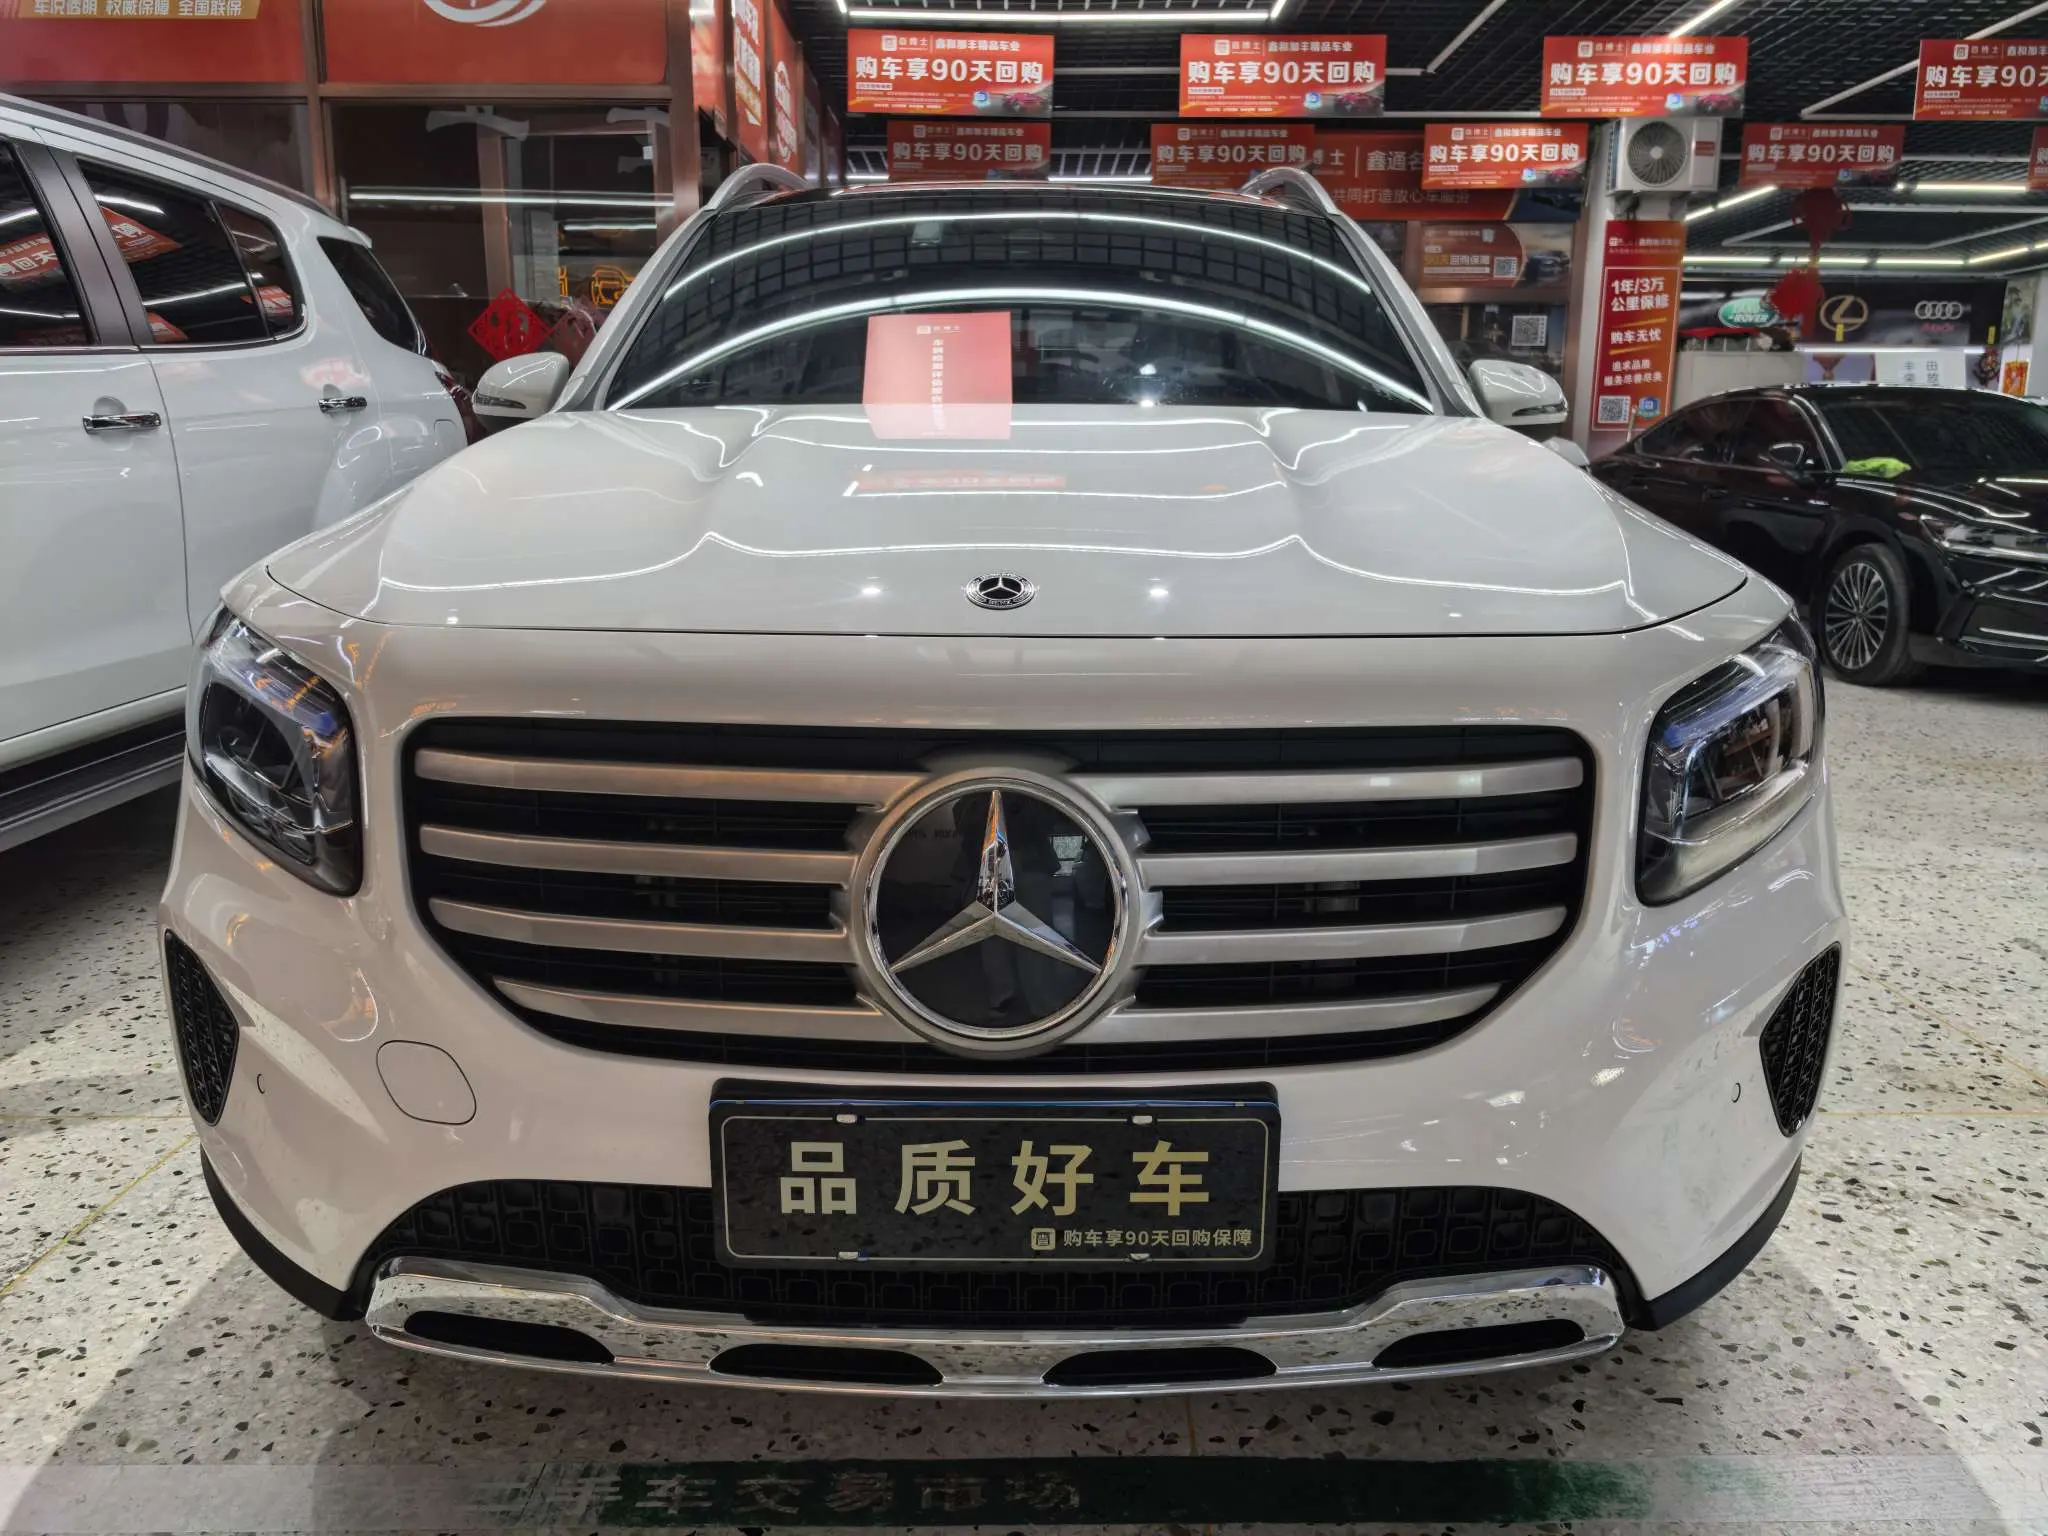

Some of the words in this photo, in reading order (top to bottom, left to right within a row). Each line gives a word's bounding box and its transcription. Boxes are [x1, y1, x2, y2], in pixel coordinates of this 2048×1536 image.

[178, 0, 242, 16] 全国联保
[855, 56, 1043, 84] 购车享90天回购
[1188, 61, 1375, 83] 购车享90天回购
[1551, 62, 1736, 85] 购车享90天回购
[893, 142, 1042, 162] 购车享90天回购
[1156, 144, 1306, 163] 购车享90天回购
[1429, 143, 1579, 163] 购车享90天回购
[1748, 144, 1895, 163] 购车享90天回购
[1611, 276, 1665, 295] 1年/3万
[1611, 294, 1669, 312] 公里保修
[1610, 328, 1662, 344] 购车无忧
[780, 1140, 1209, 1216] 品质好车
[1064, 1229, 1252, 1247] 购车享90天回购保障
